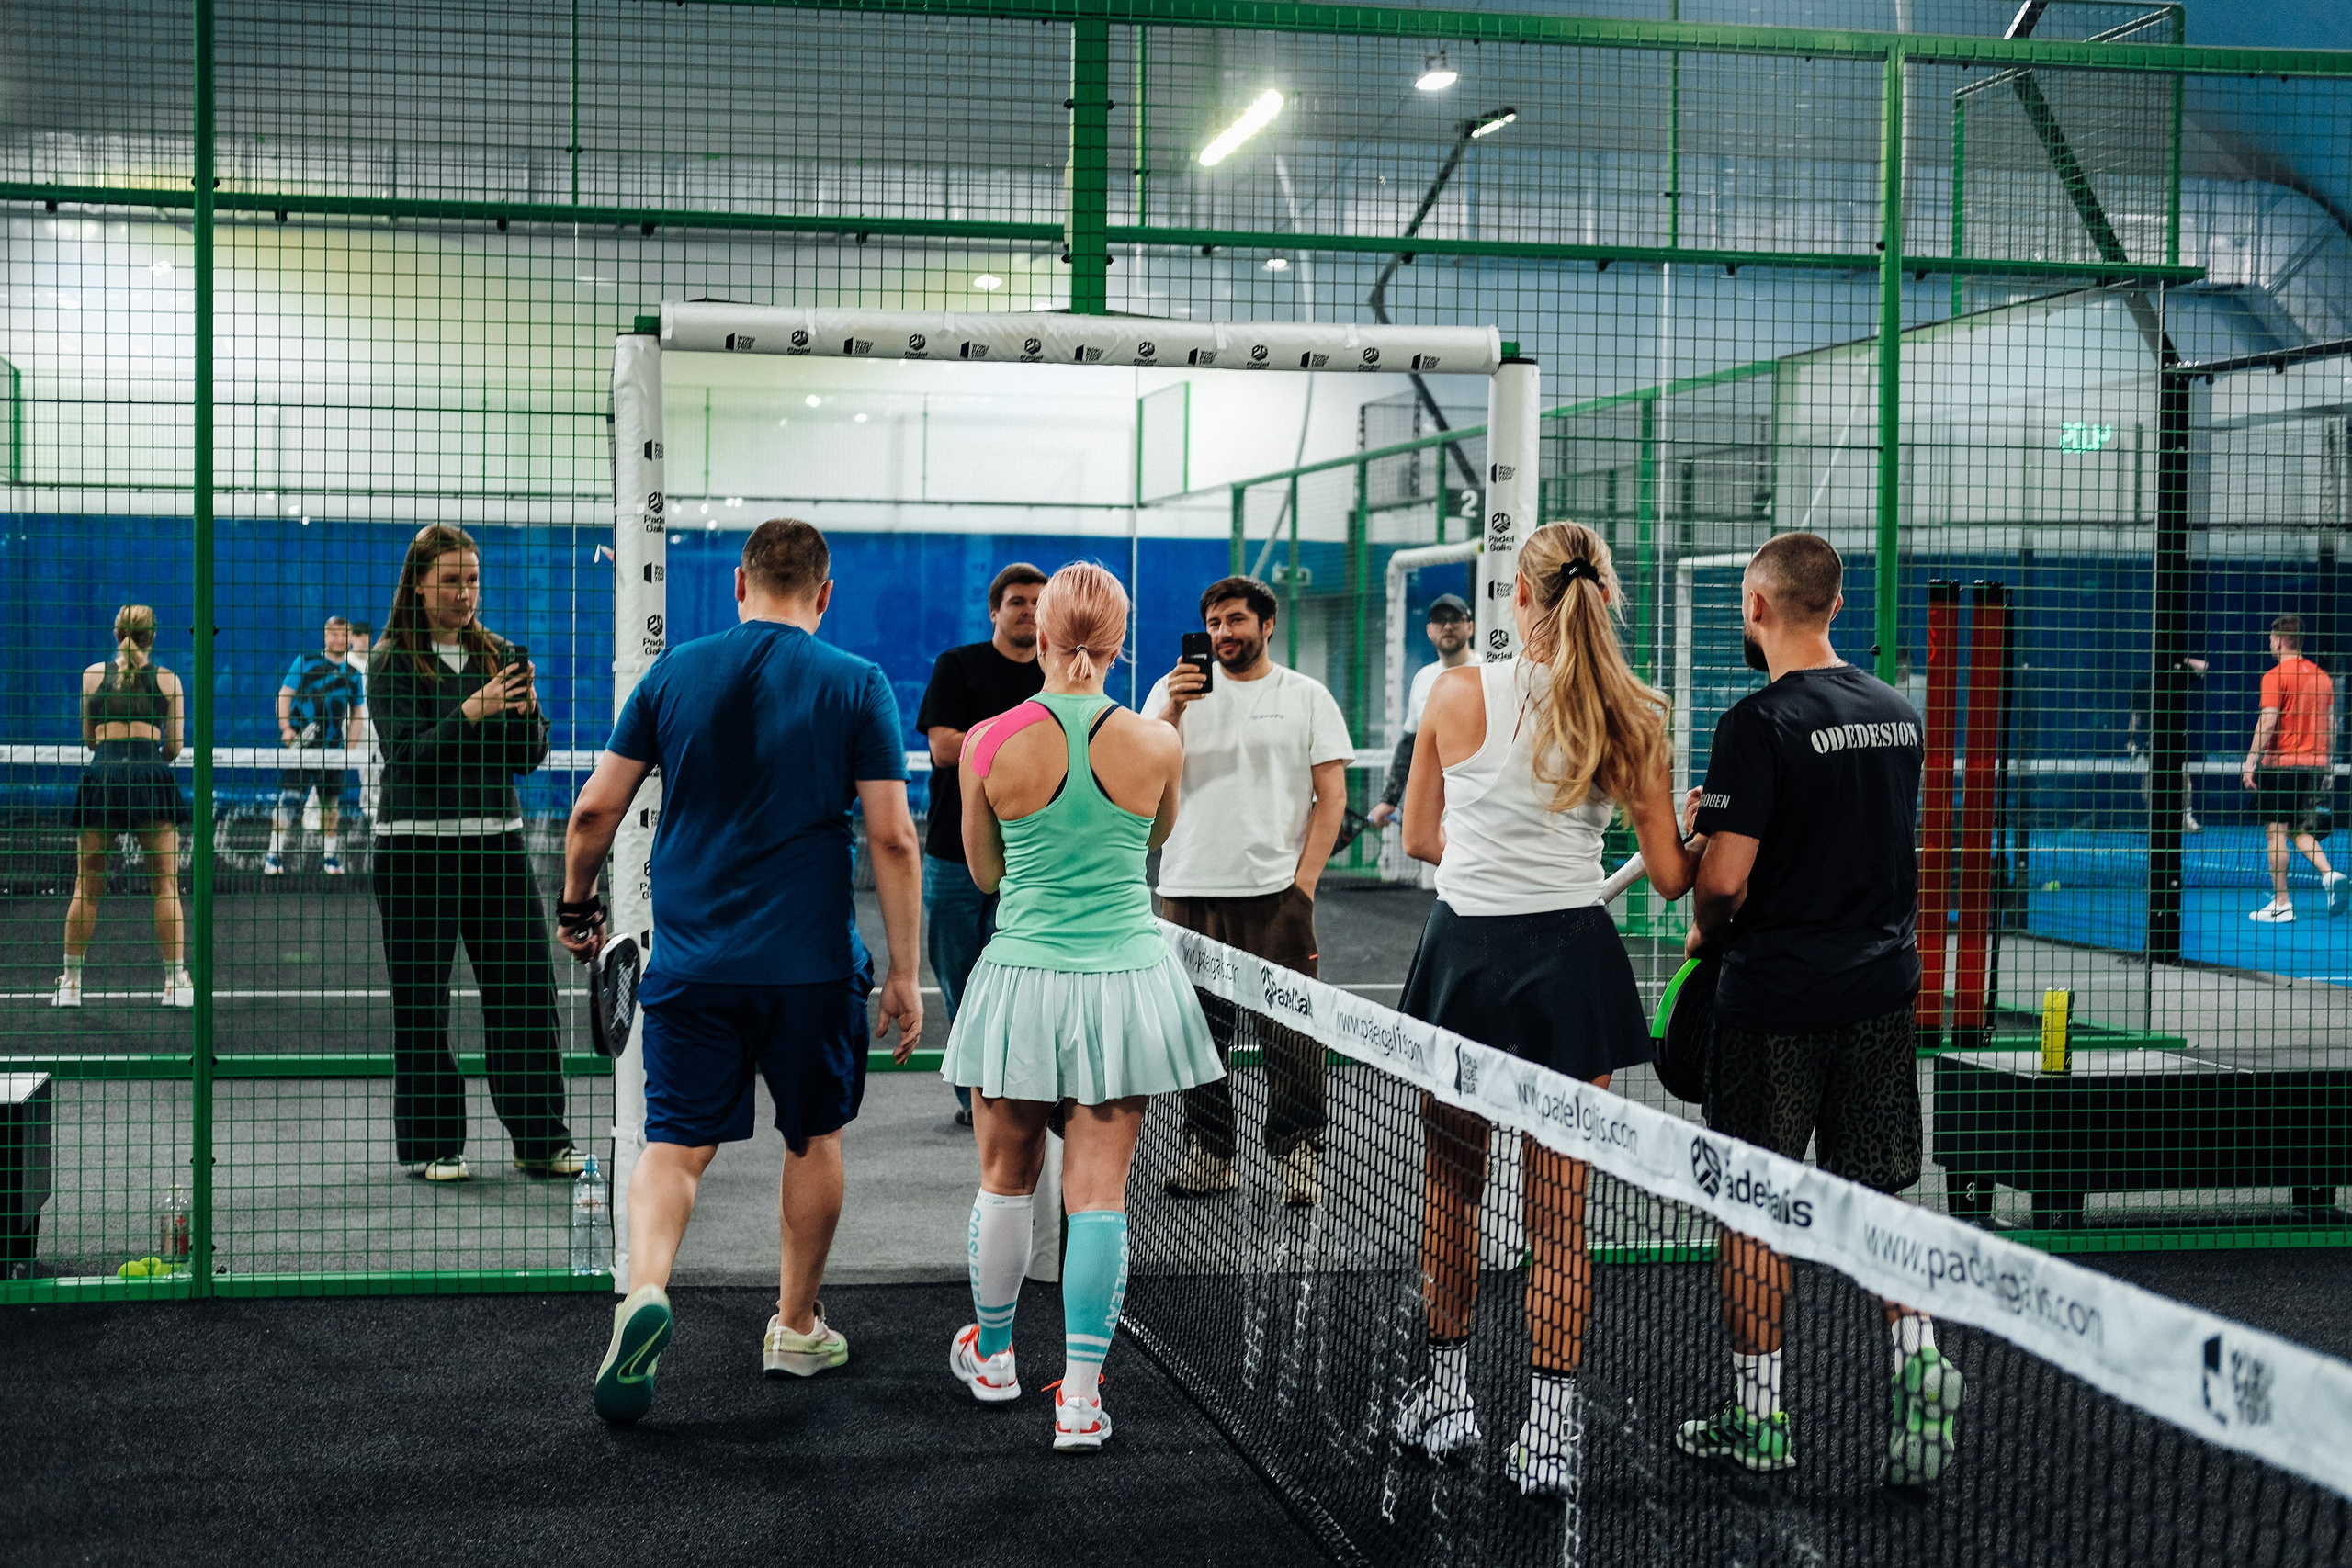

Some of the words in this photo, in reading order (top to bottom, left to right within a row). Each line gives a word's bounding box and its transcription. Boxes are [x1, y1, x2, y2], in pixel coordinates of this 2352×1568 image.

[1461, 489, 1478, 518] 2
[1488, 535, 1515, 544] Padel
[1489, 543, 1512, 552] Galis
[1487, 650, 1513, 660] Padel
[1810, 721, 1918, 754] ODEDESION
